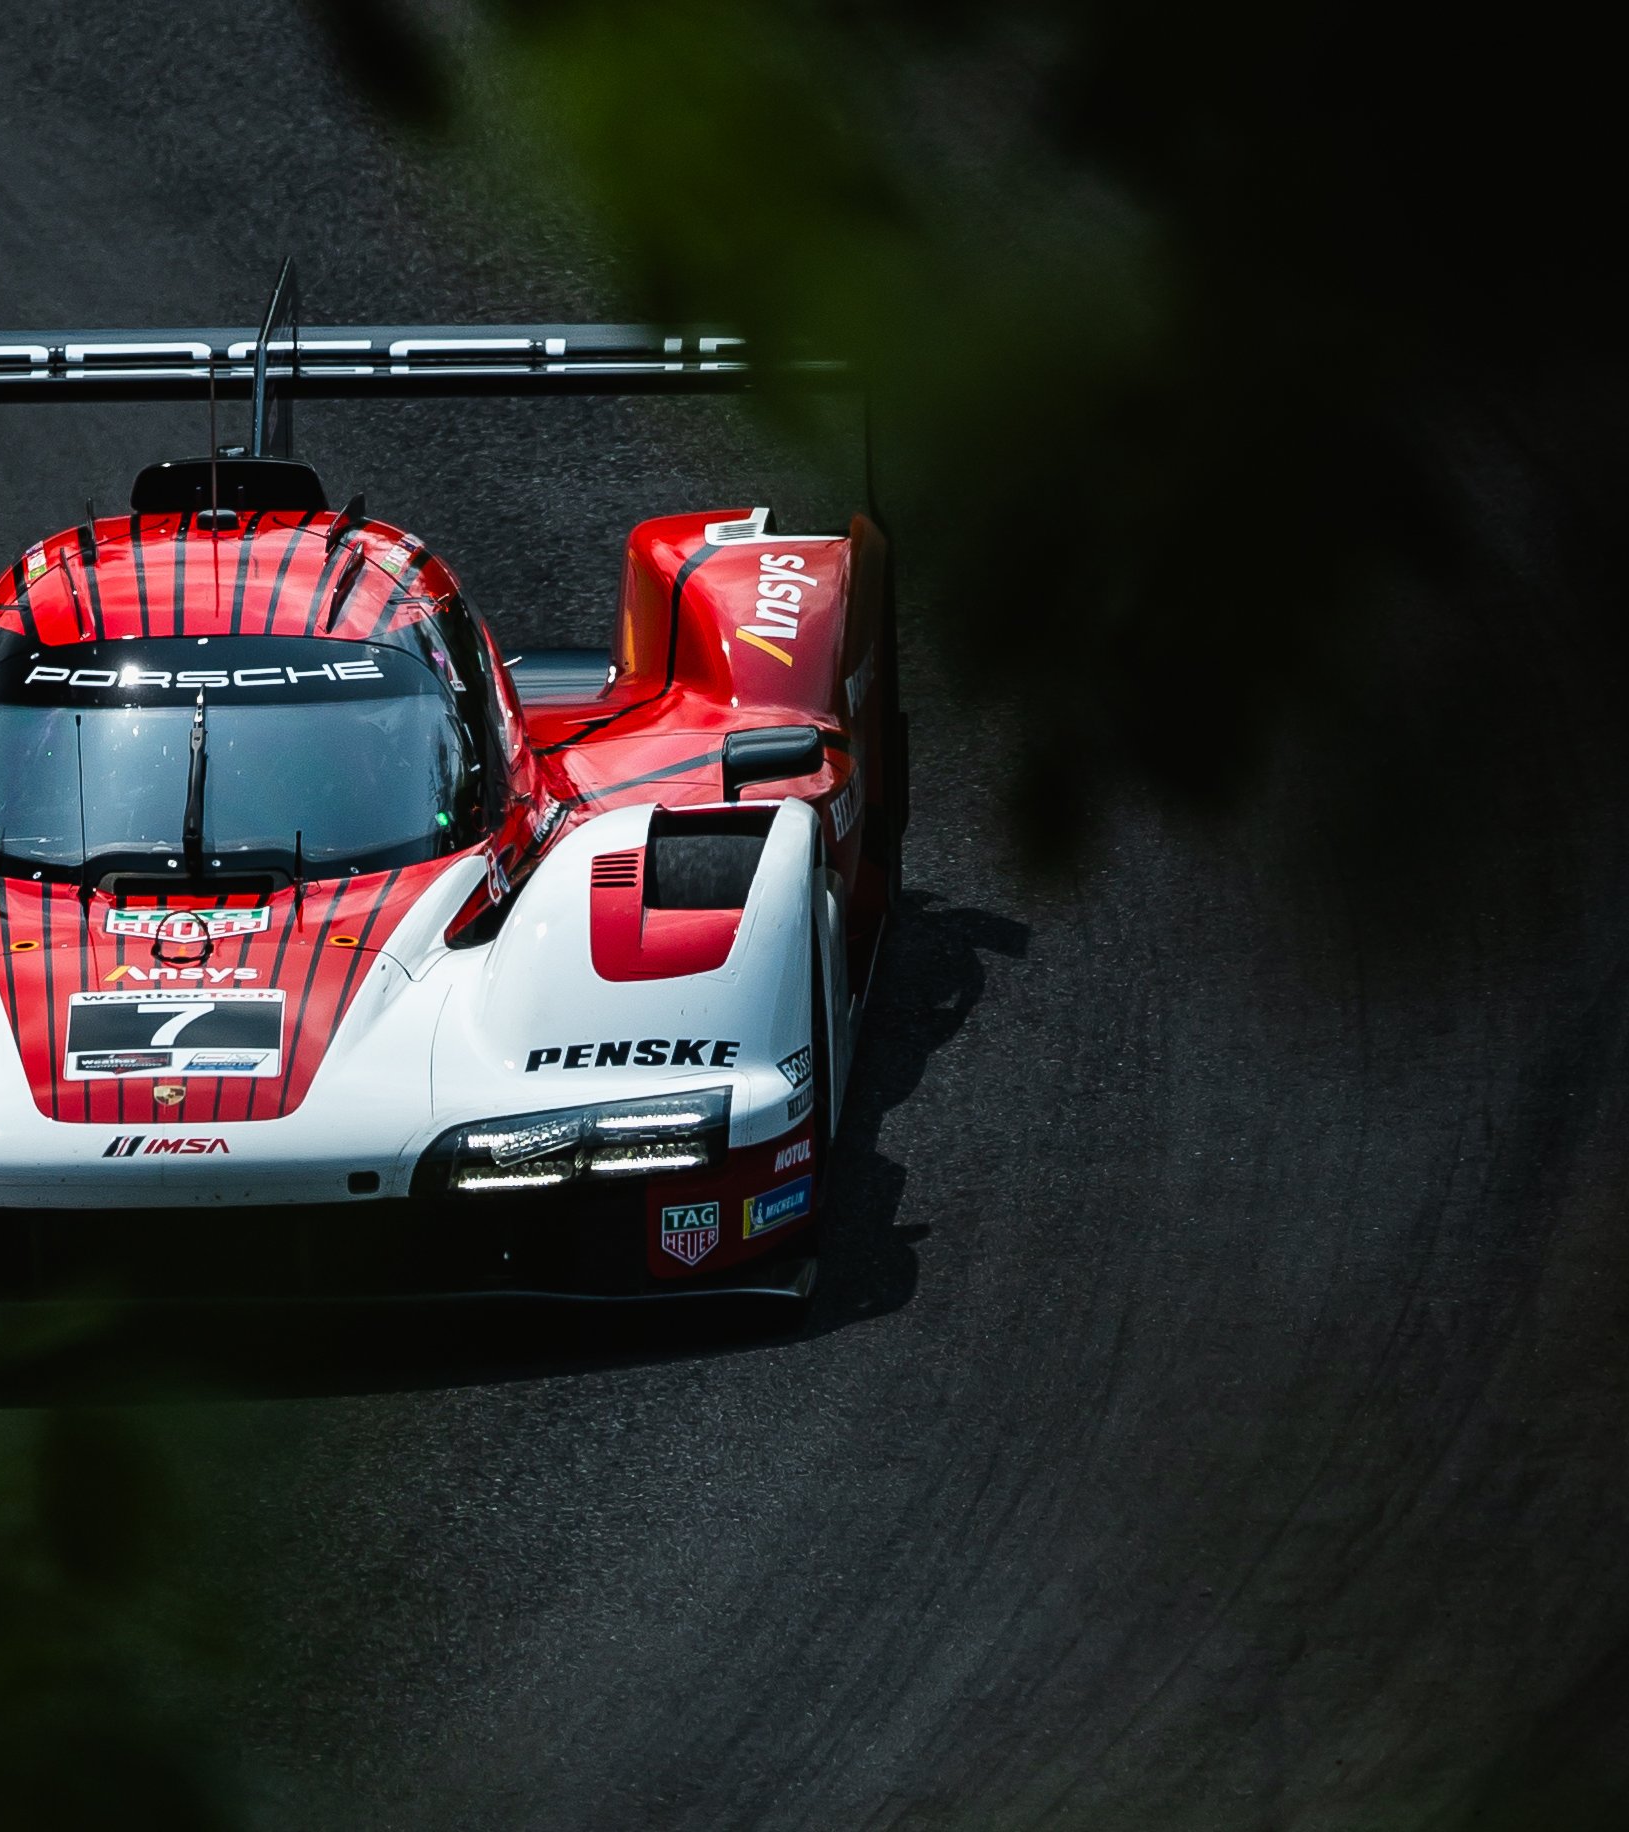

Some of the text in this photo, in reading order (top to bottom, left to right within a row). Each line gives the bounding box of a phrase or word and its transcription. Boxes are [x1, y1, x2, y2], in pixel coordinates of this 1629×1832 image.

[736, 554, 817, 667] Ansys
[25, 660, 384, 688] PORSCHE
[103, 965, 258, 983] Ansys
[81, 992, 279, 1001] WeatherTech
[137, 1002, 215, 1047] 7
[524, 1039, 740, 1073] PENSKE
[143, 1138, 230, 1154] IMSA
[774, 1139, 811, 1173] MOTUL
[667, 1207, 715, 1228] TAG
[765, 1190, 805, 1220] MICHELIN
[666, 1230, 716, 1260] HEUER
